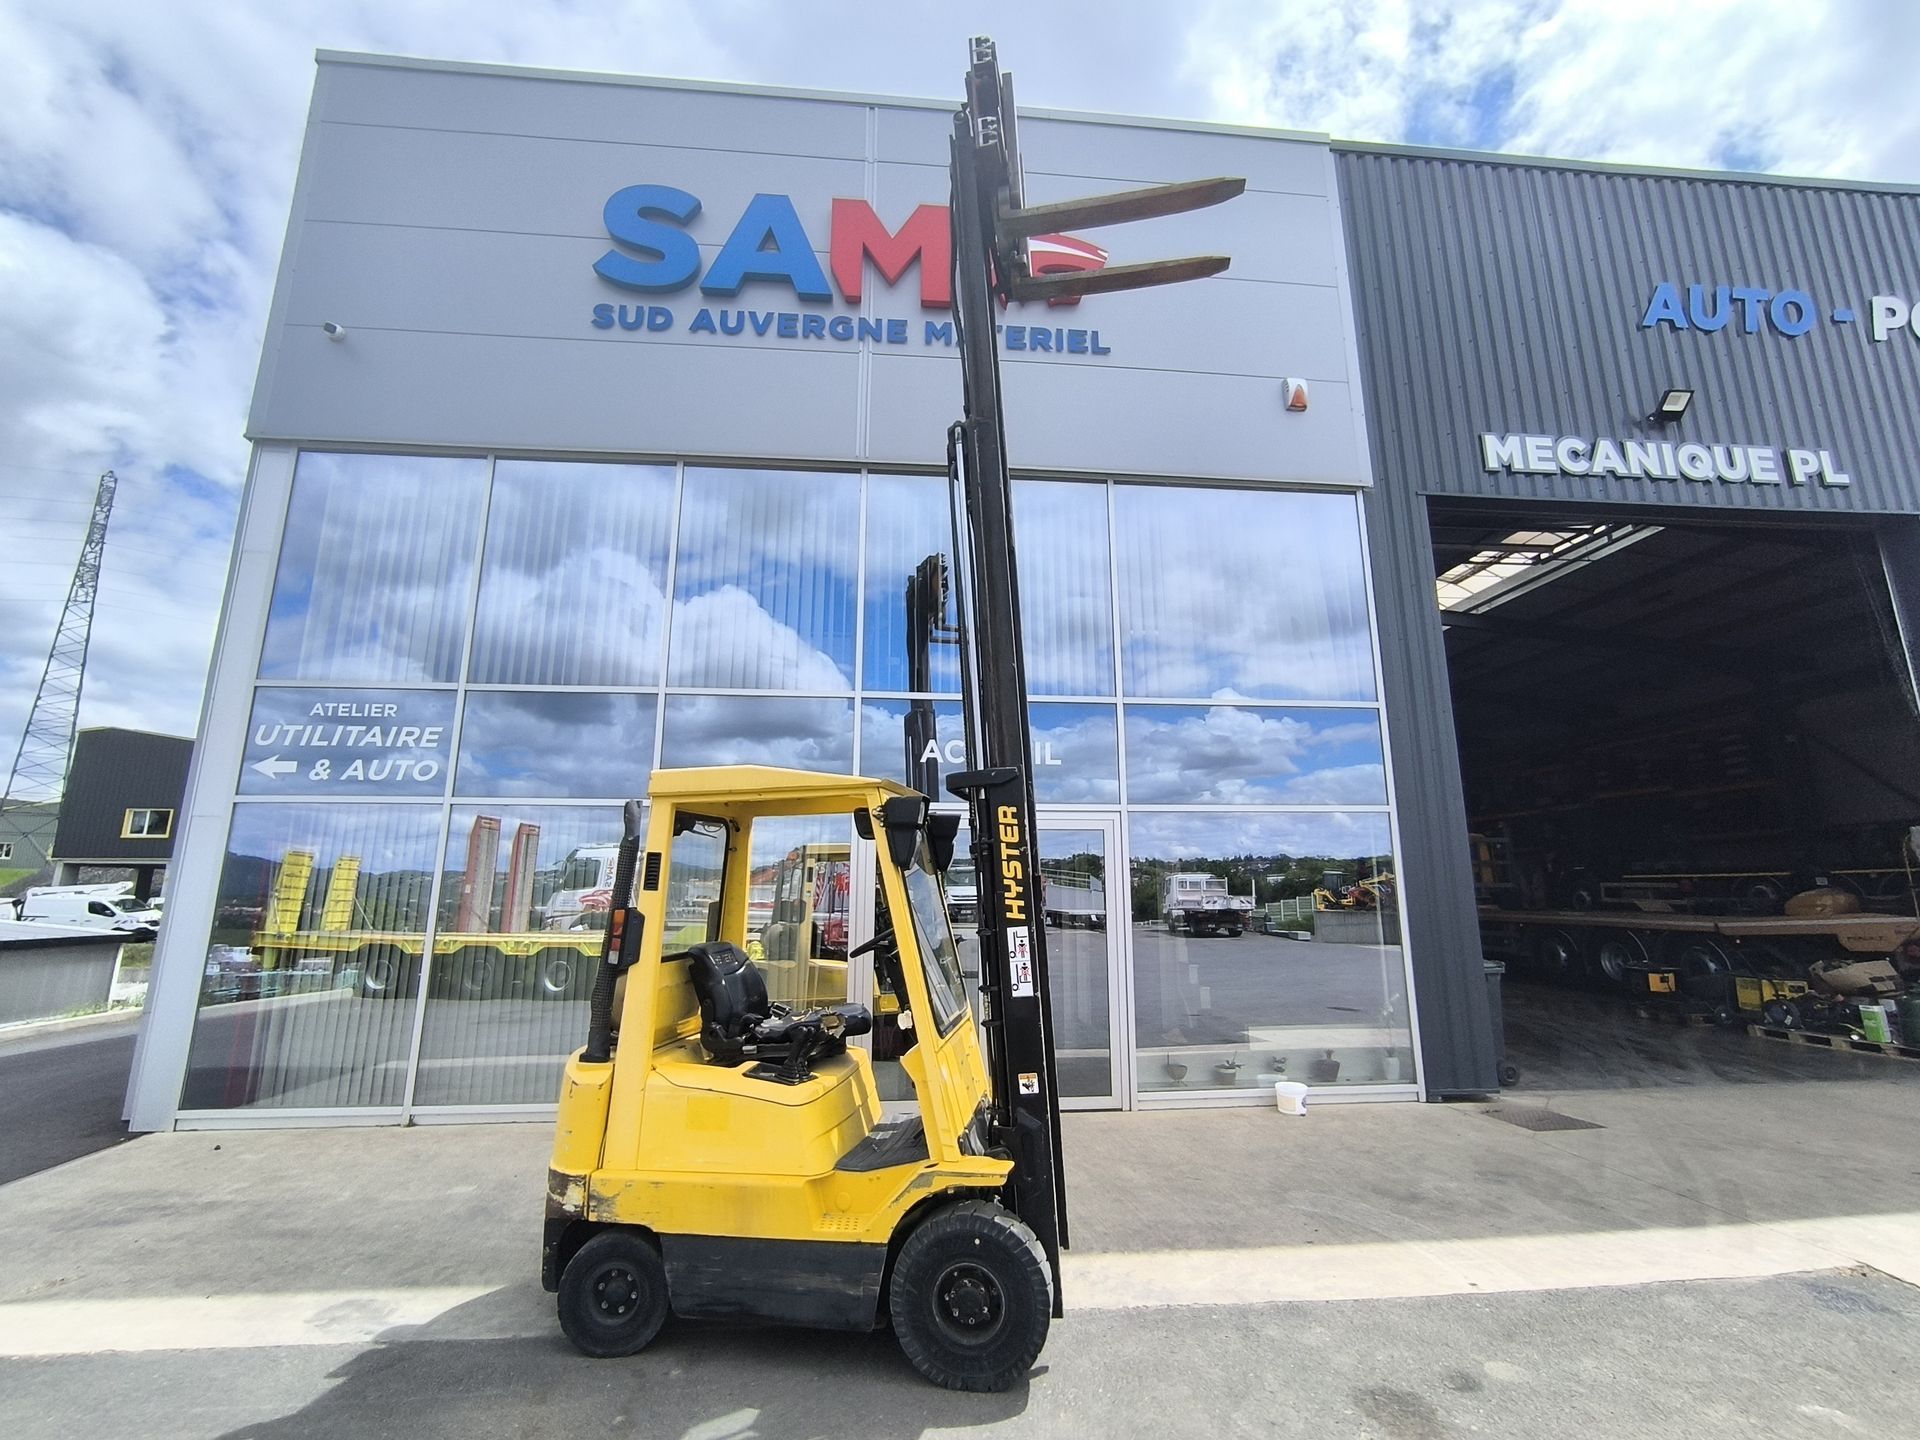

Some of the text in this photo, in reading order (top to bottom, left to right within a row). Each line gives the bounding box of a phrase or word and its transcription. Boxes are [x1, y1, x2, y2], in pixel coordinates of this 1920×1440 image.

[591, 303, 1111, 355] SUD AUVERGNE MERIEL
[1642, 282, 1816, 337] AUTO
[1481, 432, 1850, 487] MECANIQUE PL
[310, 703, 398, 717] ATELIER
[255, 725, 443, 748] UTILITAIRE
[920, 739, 1062, 765] ACIL
[308, 759, 439, 781] & AUTO
[998, 805, 1026, 920] HYSTER
